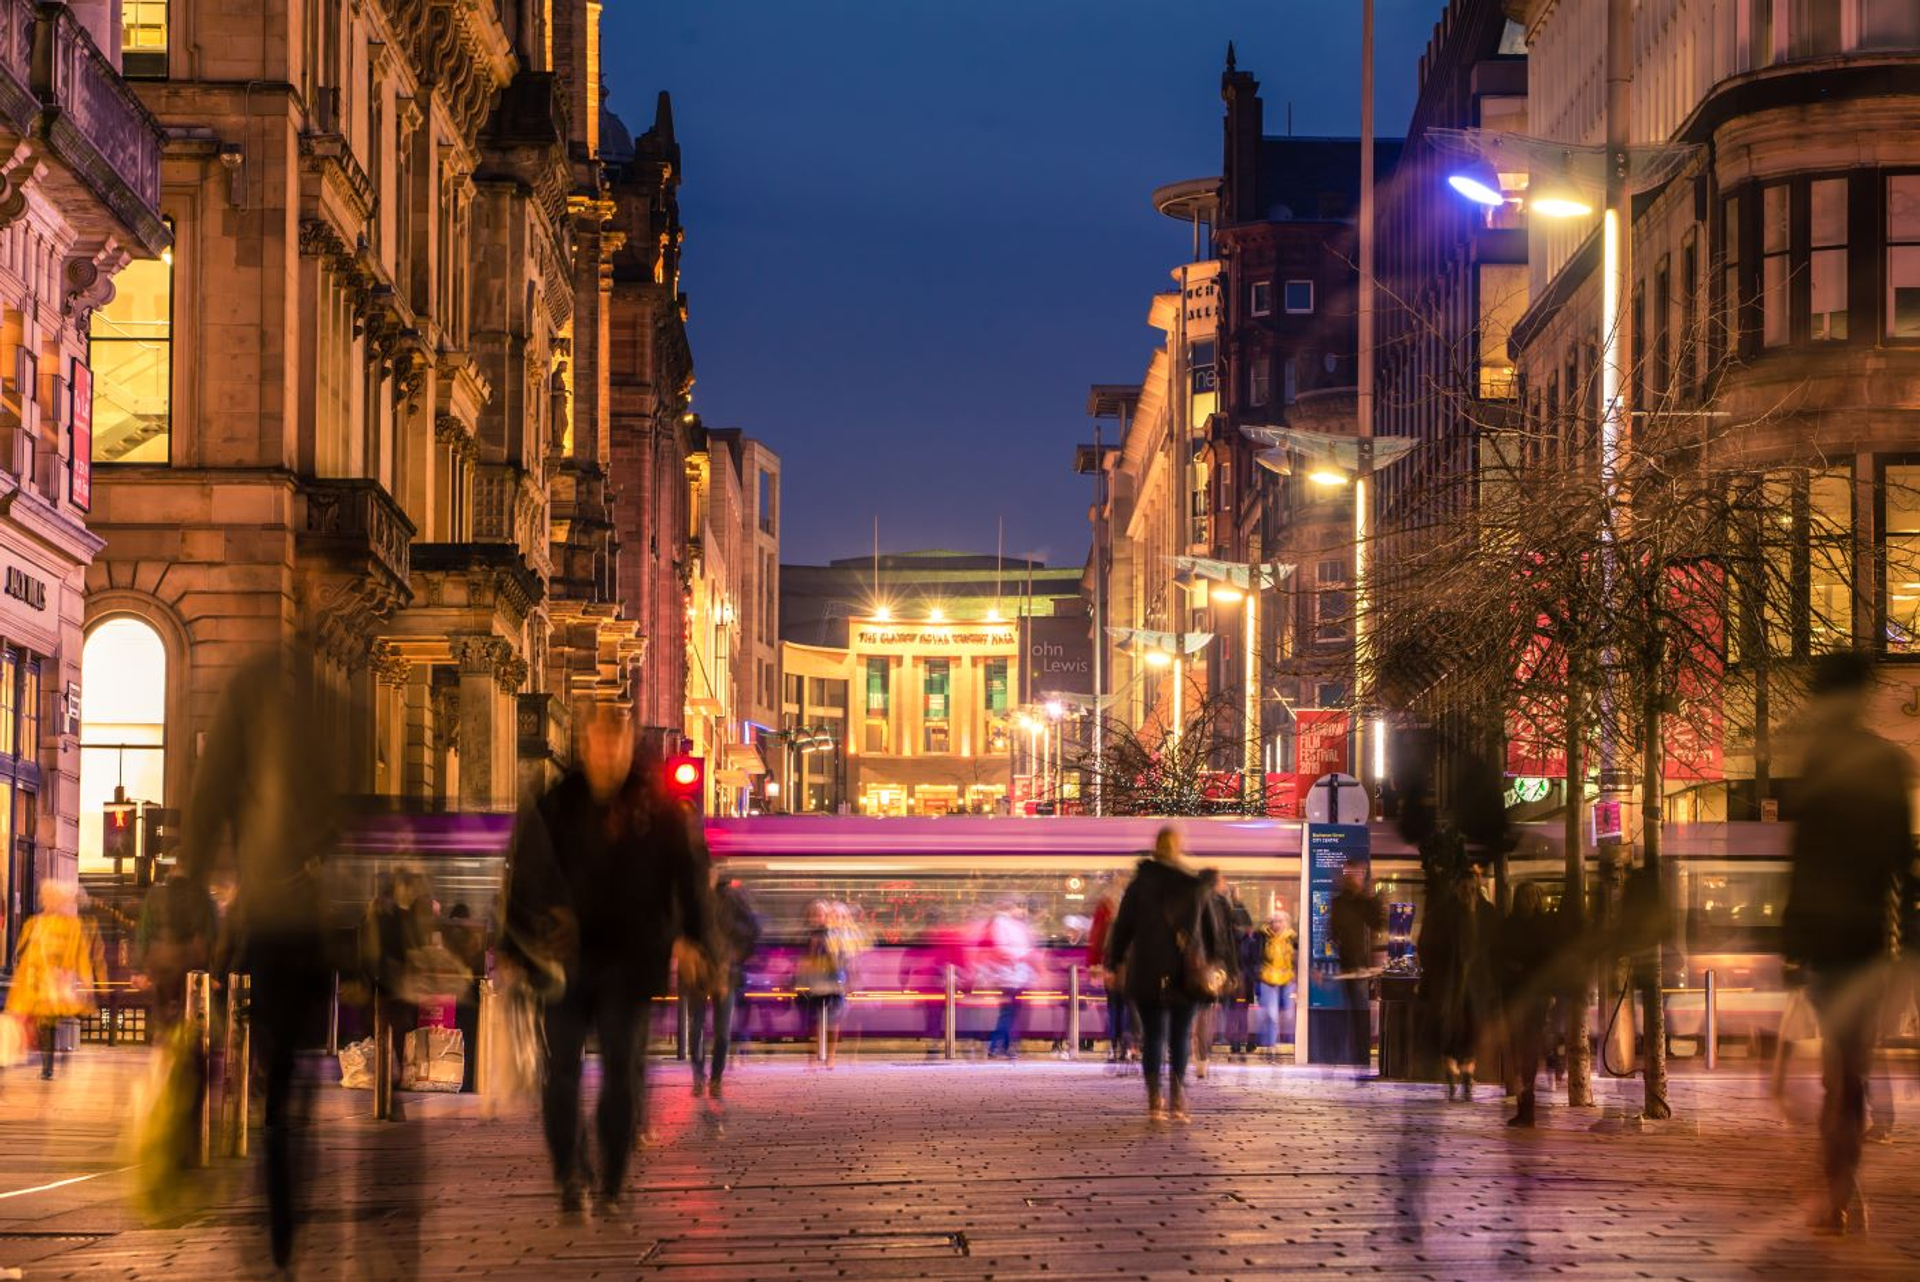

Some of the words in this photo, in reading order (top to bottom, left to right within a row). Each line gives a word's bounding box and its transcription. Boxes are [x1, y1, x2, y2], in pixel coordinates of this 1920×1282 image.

[1196, 370, 1216, 389] ne
[1032, 641, 1063, 656] ohn
[1044, 657, 1088, 672] Lewis
[1300, 736, 1320, 749] FILM
[1300, 749, 1339, 762] FESTIVAL
[1299, 762, 1320, 775] 2019
